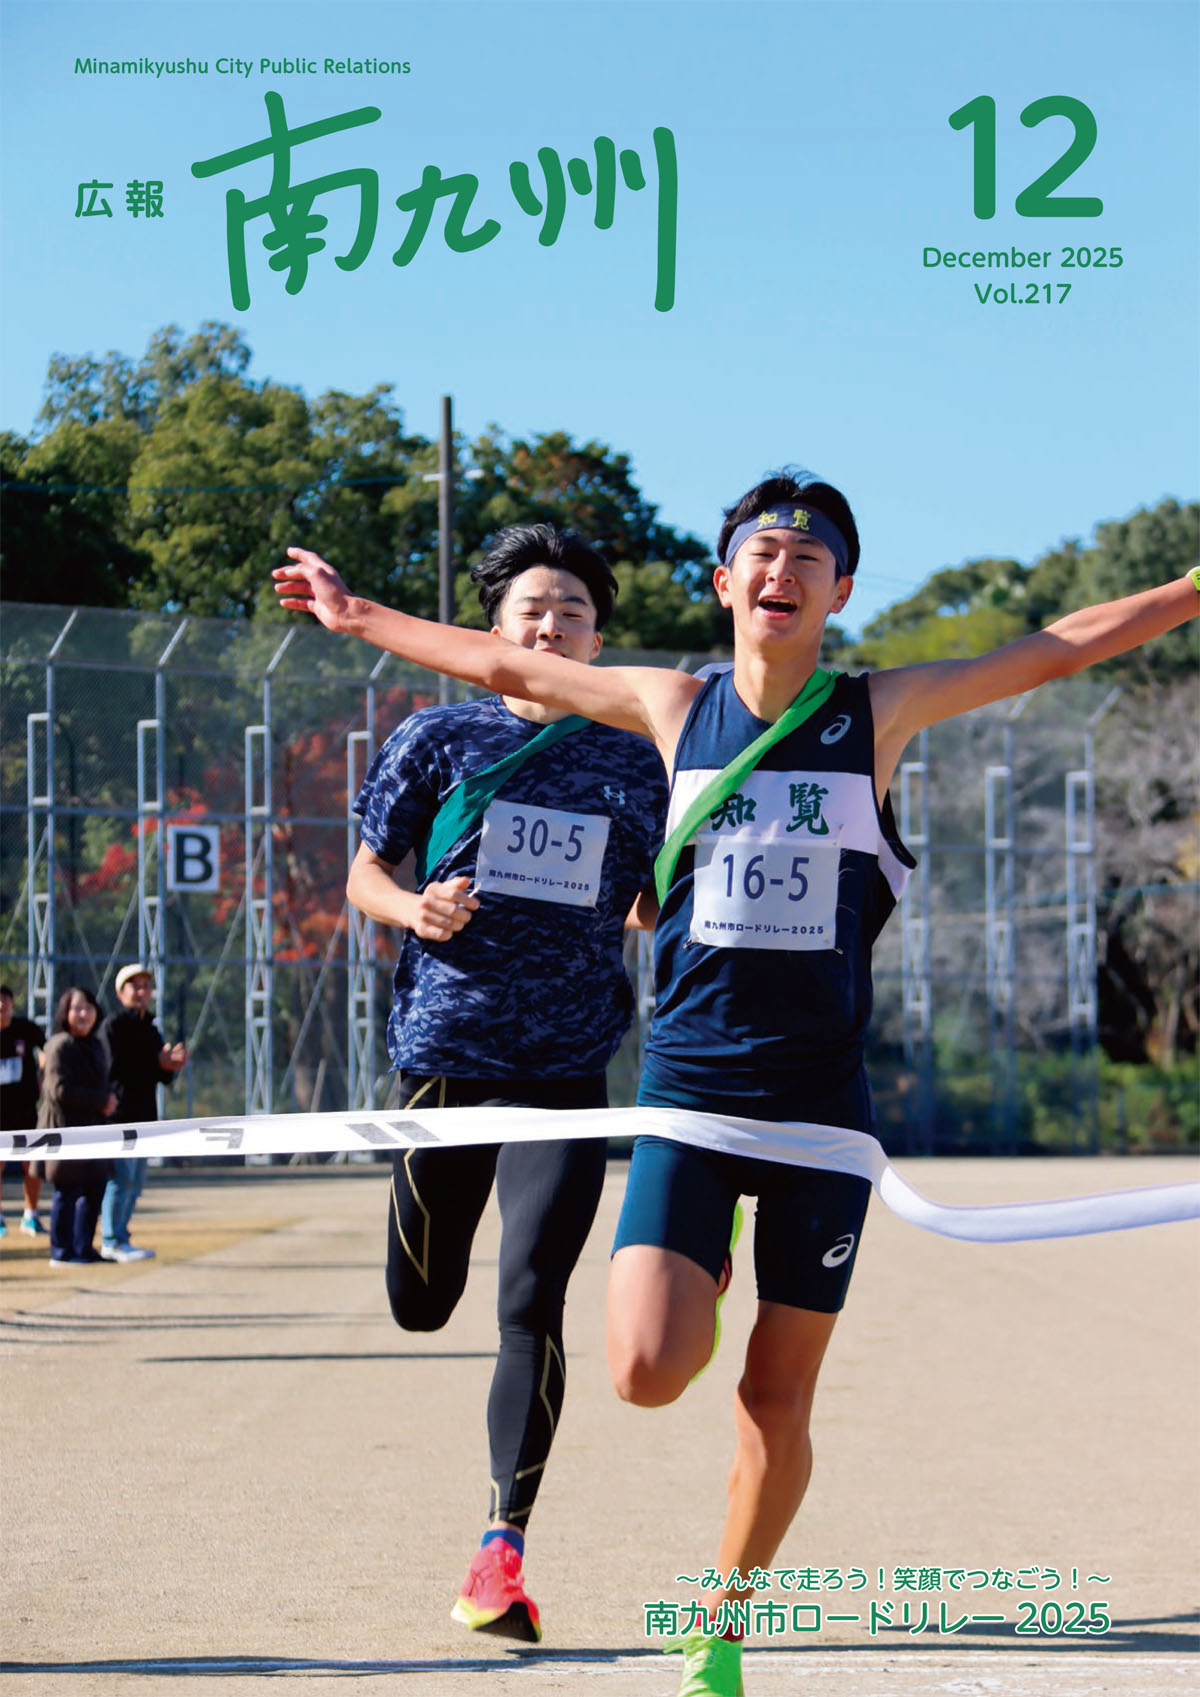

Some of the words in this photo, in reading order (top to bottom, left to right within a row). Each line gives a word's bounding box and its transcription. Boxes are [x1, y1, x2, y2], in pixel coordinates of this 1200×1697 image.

[757, 508, 812, 530] 知覧
[710, 782, 830, 836] 知覧
[175, 832, 214, 884] B
[507, 815, 585, 862] 30-5
[723, 853, 810, 902] 16-5
